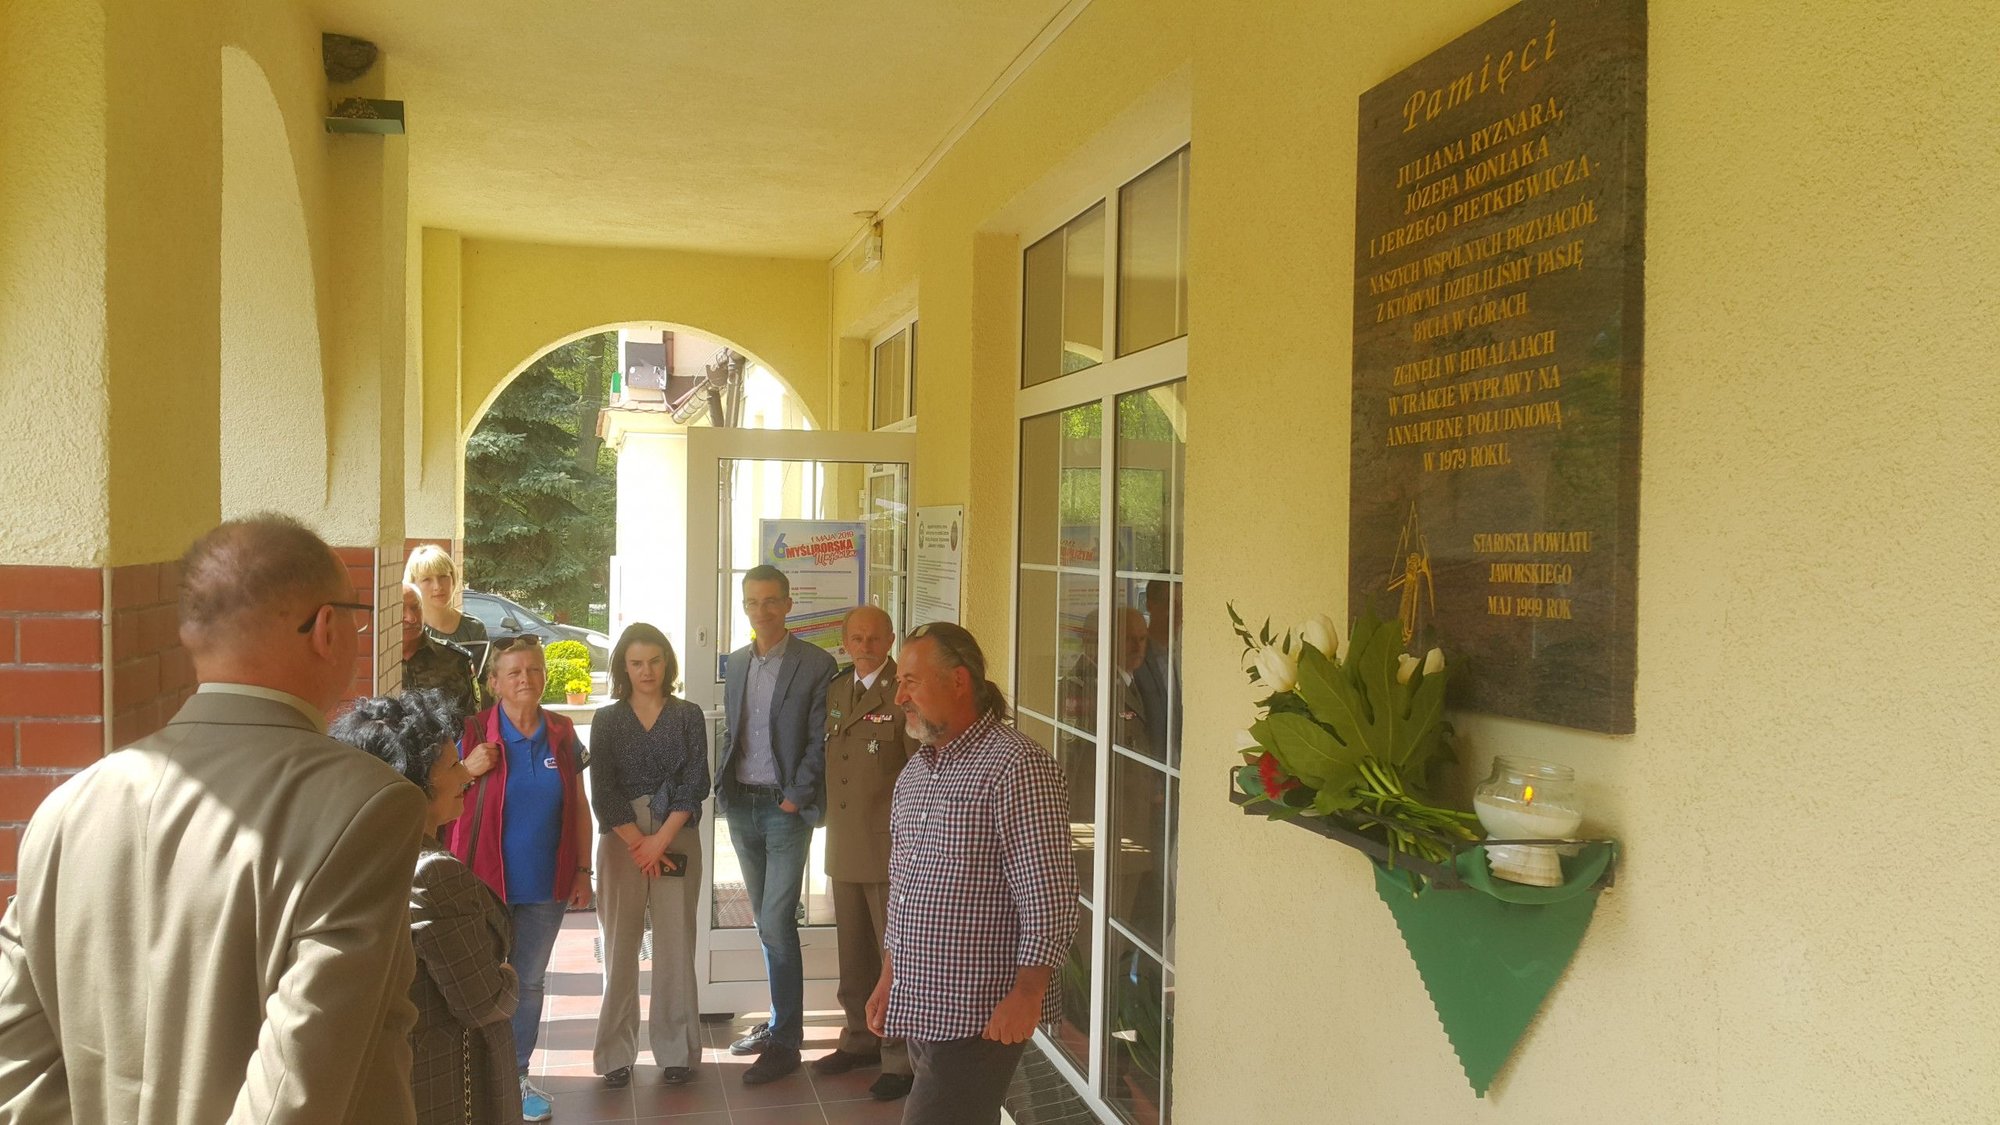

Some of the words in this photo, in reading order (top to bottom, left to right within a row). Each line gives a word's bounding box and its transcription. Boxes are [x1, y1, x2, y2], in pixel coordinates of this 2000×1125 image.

[1402, 18, 1557, 133] Pamięci
[1396, 138, 1465, 189] JULIANA
[1470, 96, 1564, 155] RYZNARA,
[1404, 174, 1458, 215] JÓZEFA
[1464, 135, 1549, 190] KONIAKA
[1378, 210, 1447, 255] JERZEGO
[1453, 154, 1591, 227] PIETKIEWICZA
[1369, 266, 1419, 296] NASZYCH
[1423, 237, 1501, 277] WSPÓLNYCH
[1506, 195, 1598, 250] PRZYJACIÓŁ
[1387, 286, 1440, 320] KTÓRYMI
[1445, 255, 1532, 303] DZIELILIŚMY
[1537, 239, 1584, 276] PASJĘ
[1413, 316, 1449, 343] BYCIA
[1453, 310, 1465, 332] W
[1468, 292, 1528, 327] GÓRACH
[1445, 353, 1457, 375] W
[1460, 330, 1556, 372] HIMALAJACH
[1388, 396, 1399, 417] W
[1401, 385, 1455, 414] TRAKCIE
[1459, 368, 1535, 404] WYPRAWY
[1539, 365, 1561, 391] NA
[1467, 400, 1563, 436] POŁUDNIOWĄ
[1424, 453, 1434, 472] W
[1440, 449, 1466, 471] 1979
[774, 533, 788, 558] 6
[1473, 533, 1529, 552] STAROSTA
[1533, 531, 1591, 552] POWIATU
[1489, 564, 1572, 585] JAWORSKIEGO
[1487, 596, 1512, 615] MAJ
[1516, 596, 1542, 617] 1999
[1547, 598, 1572, 620] ROK
